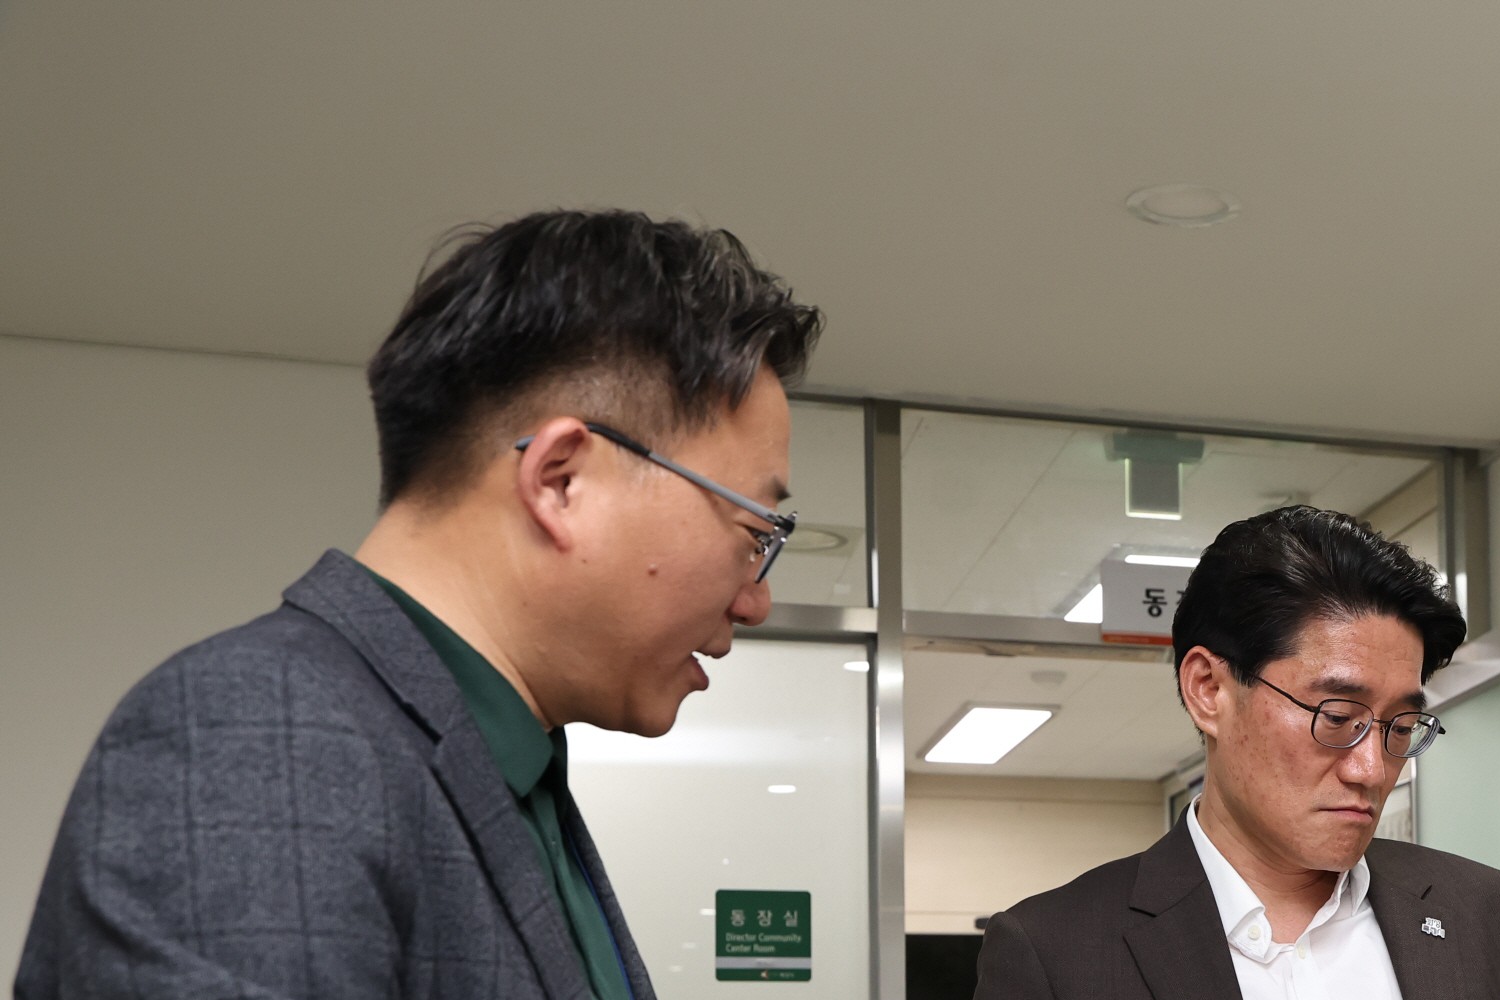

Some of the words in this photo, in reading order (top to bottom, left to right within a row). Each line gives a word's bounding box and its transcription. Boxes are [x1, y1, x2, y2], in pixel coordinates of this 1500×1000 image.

[725, 932, 757, 942] Director
[758, 932, 802, 943] Community
[725, 943, 752, 953] Center
[753, 943, 776, 953] Room
